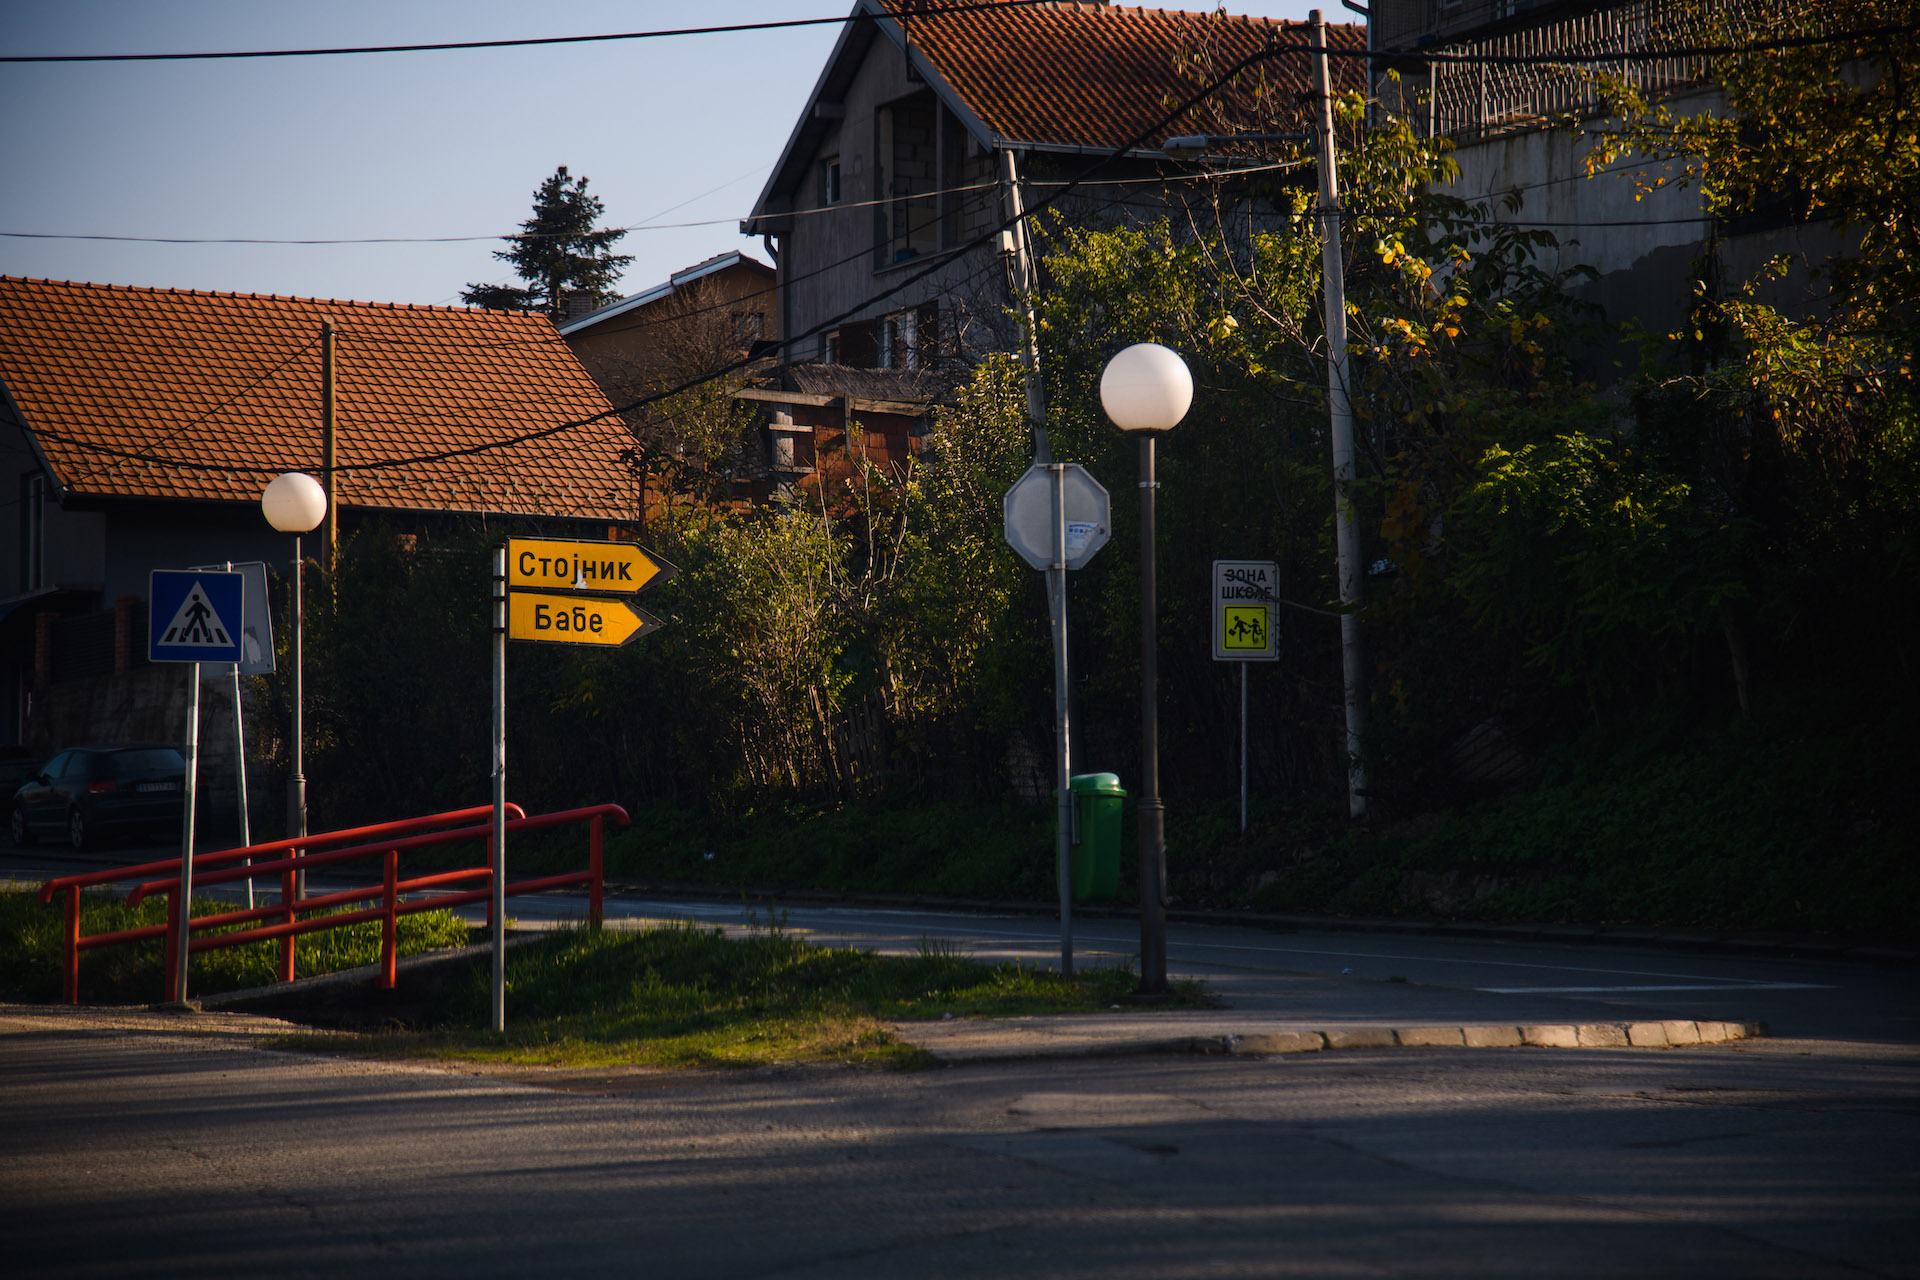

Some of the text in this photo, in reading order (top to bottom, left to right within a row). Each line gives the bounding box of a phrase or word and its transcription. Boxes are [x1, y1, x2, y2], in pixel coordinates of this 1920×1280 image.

[519, 552, 632, 584] Стојник
[1226, 569, 1266, 582] ЗОНА
[535, 605, 602, 632] Бабе
